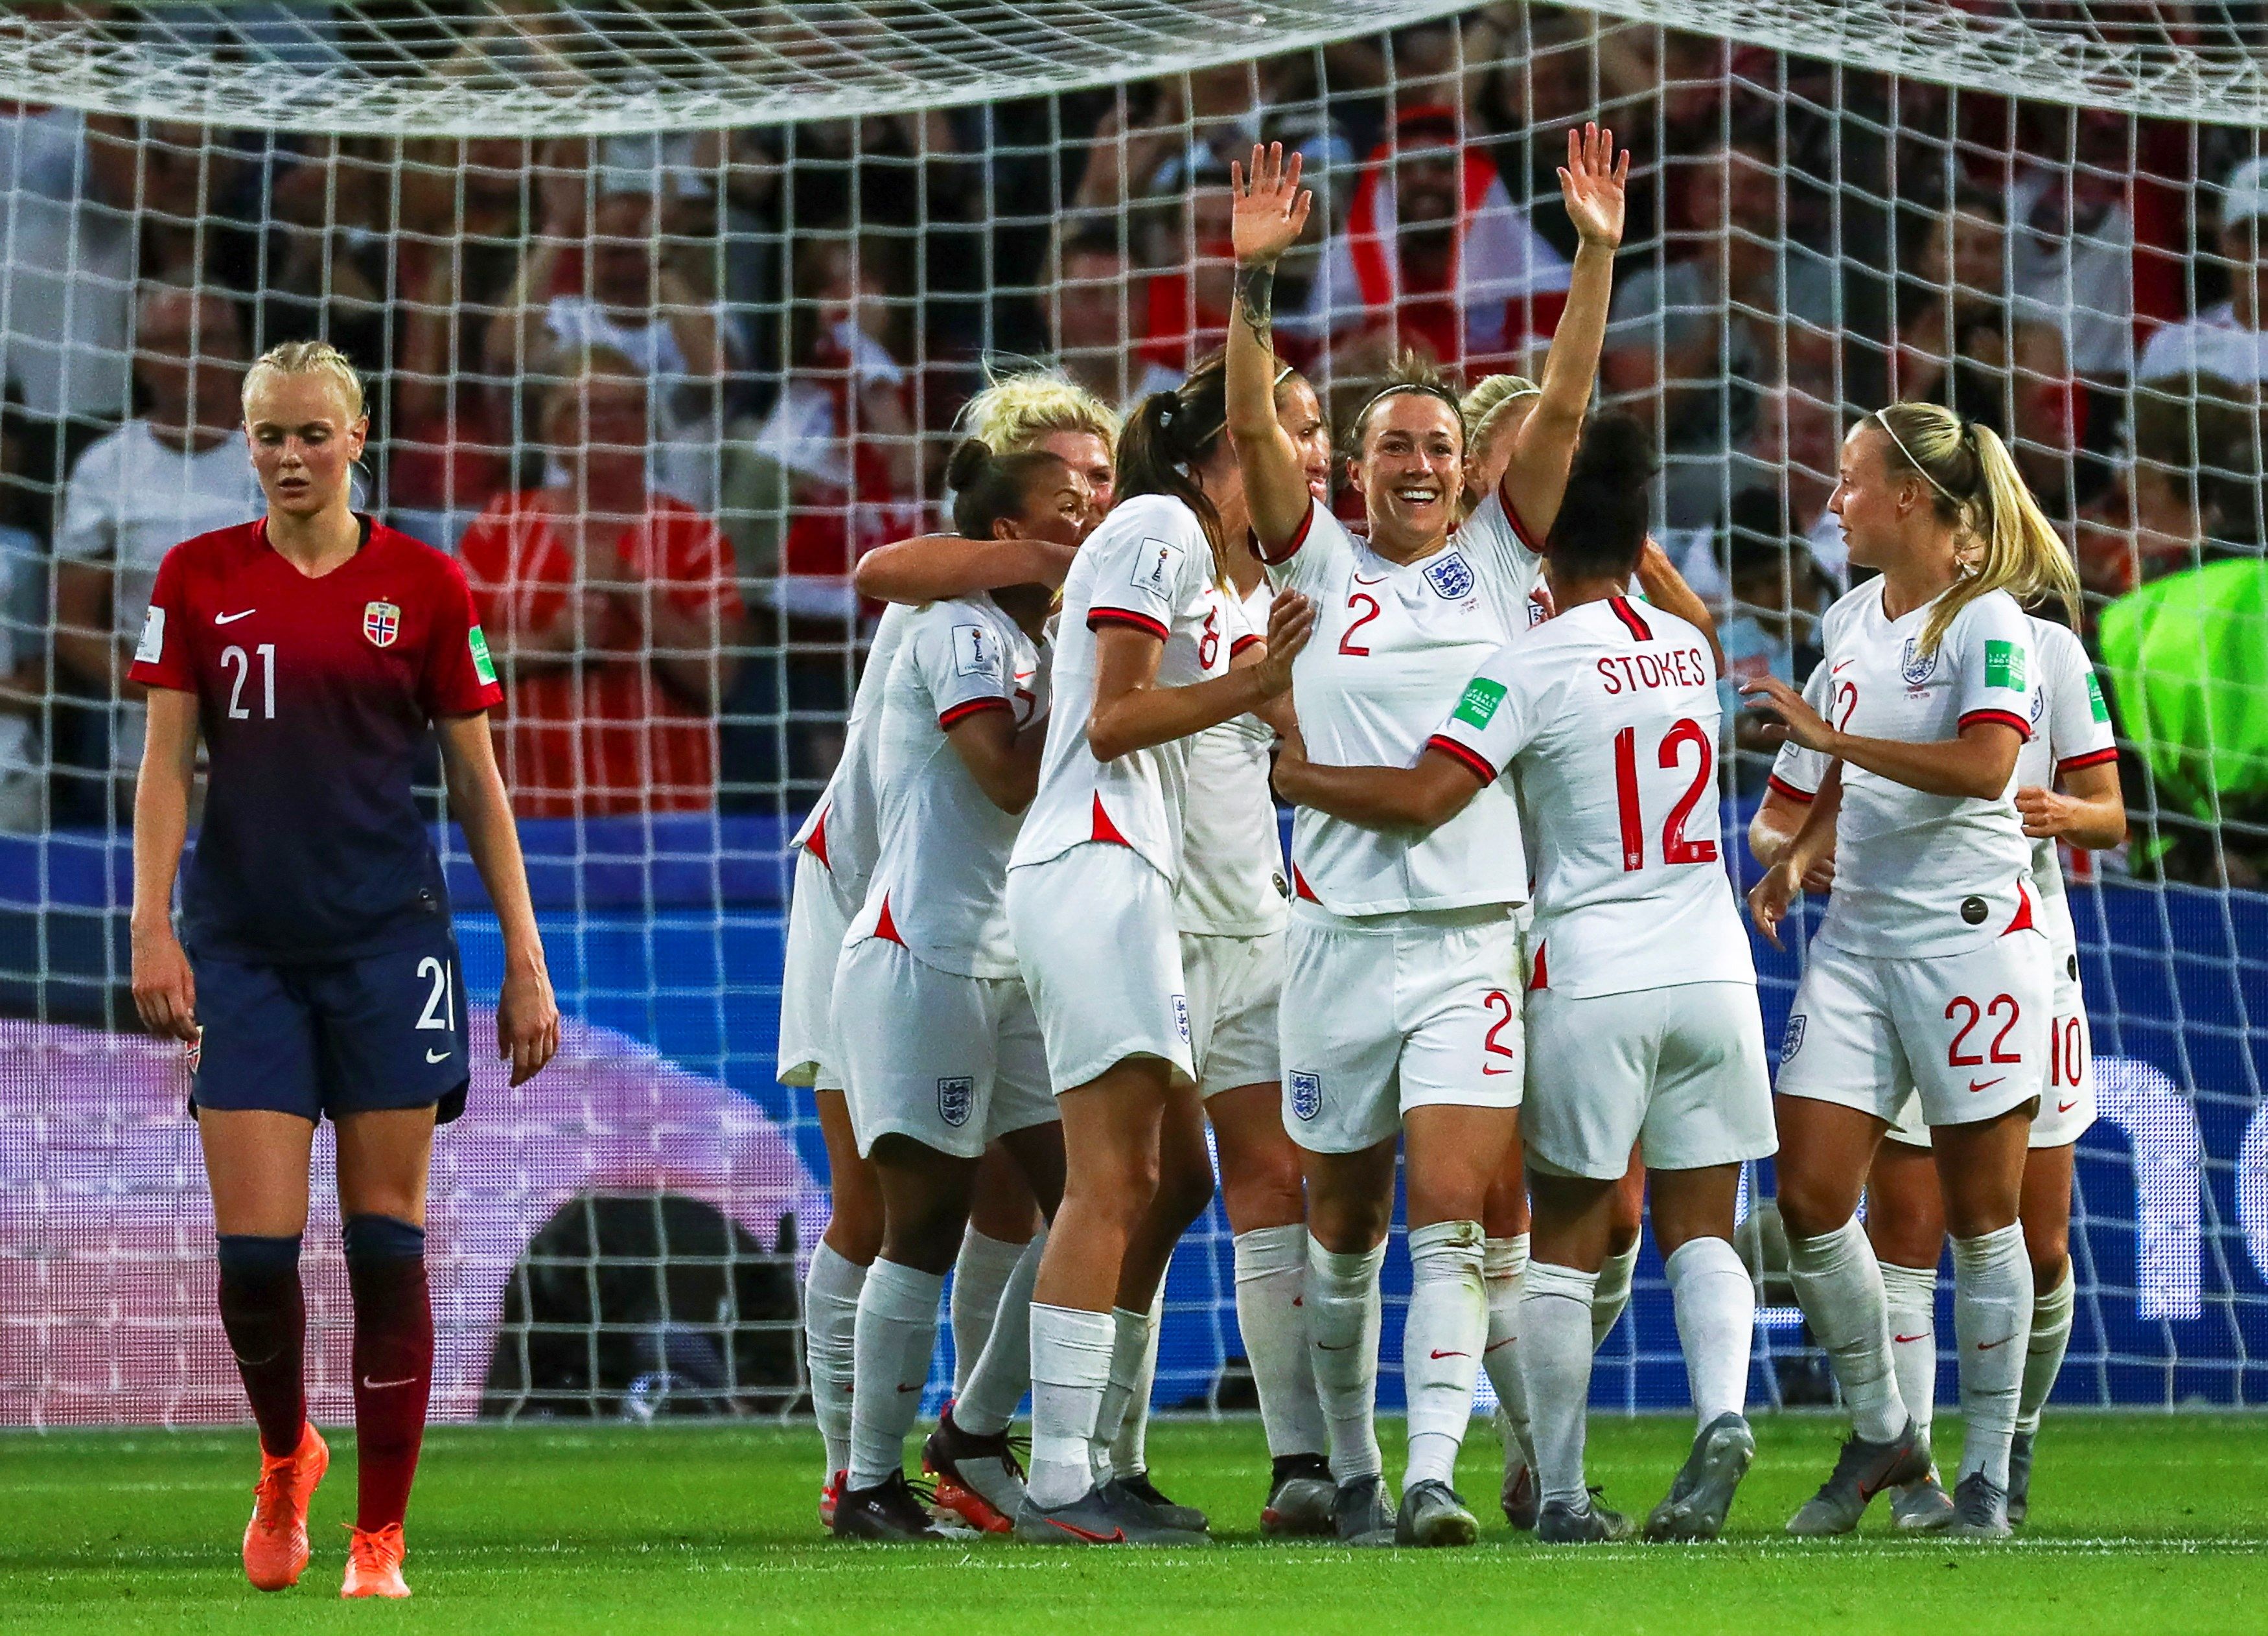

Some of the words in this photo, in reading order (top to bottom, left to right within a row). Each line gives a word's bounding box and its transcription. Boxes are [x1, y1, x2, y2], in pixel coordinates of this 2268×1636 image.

[1199, 605, 1221, 670] 8
[1339, 593, 1380, 656] 2
[220, 643, 275, 719] 21
[1597, 648, 1706, 694] STOKES
[1831, 681, 1858, 732] 2
[1614, 718, 1718, 872] 12
[415, 956, 455, 1031] 21
[1484, 991, 1513, 1058] 2
[1945, 993, 2021, 1067] 22
[2052, 1017, 2081, 1087] 10
